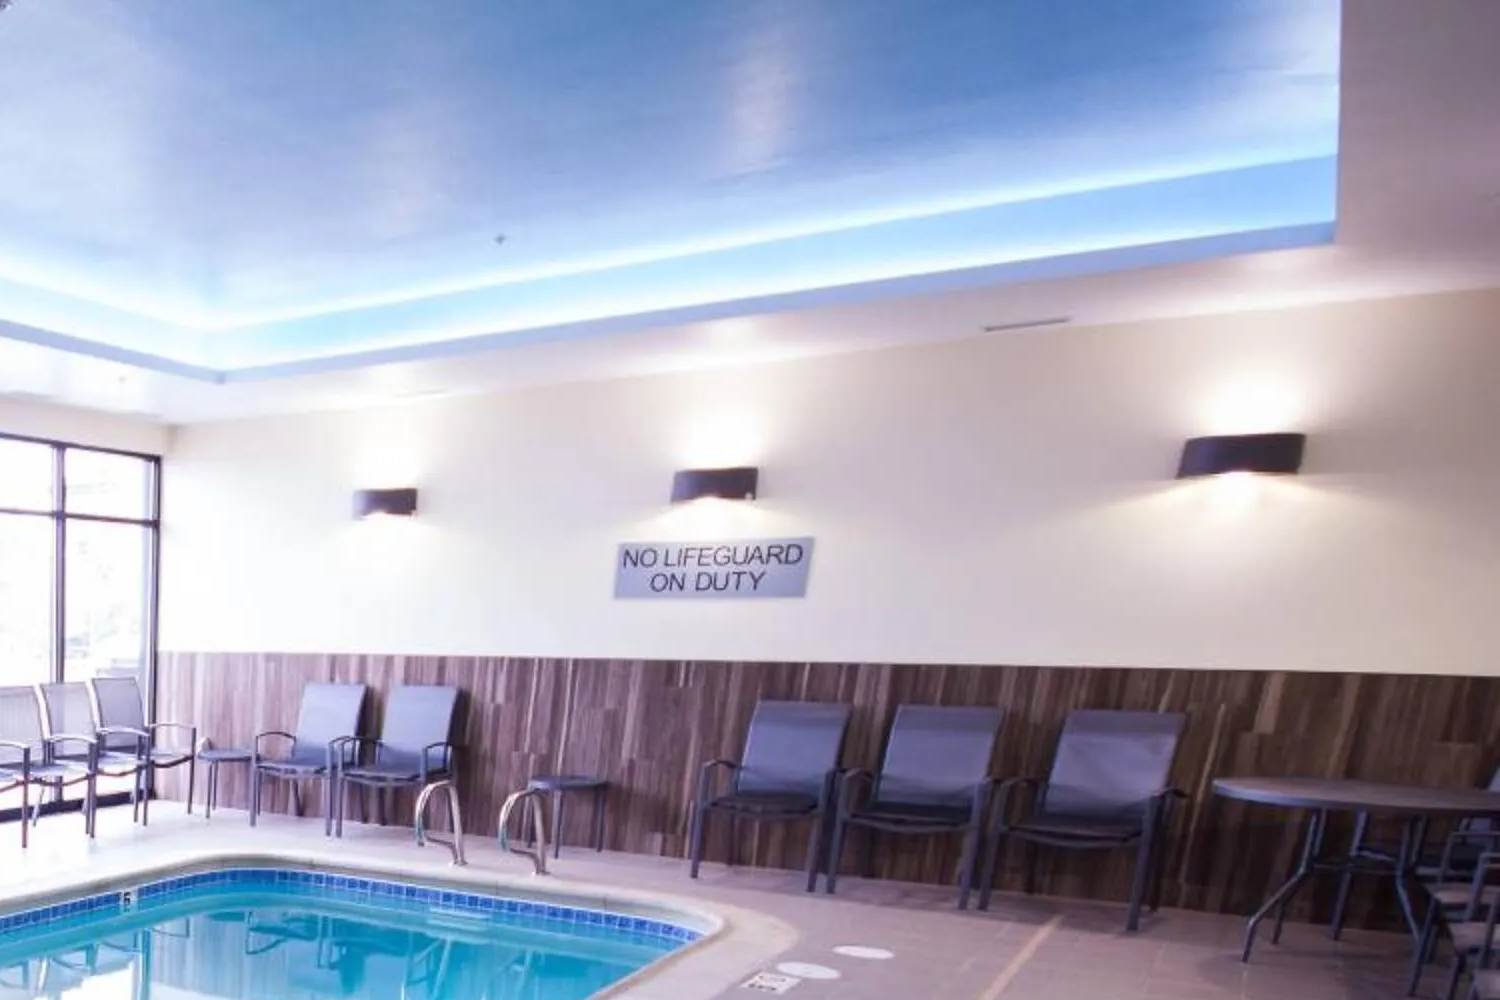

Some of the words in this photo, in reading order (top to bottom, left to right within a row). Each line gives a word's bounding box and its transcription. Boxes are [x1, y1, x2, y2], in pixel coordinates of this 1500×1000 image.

[622, 547, 658, 568] NO
[663, 544, 804, 567] LIFEGUARD
[650, 572, 687, 593] ON
[694, 571, 767, 593] DUTY
